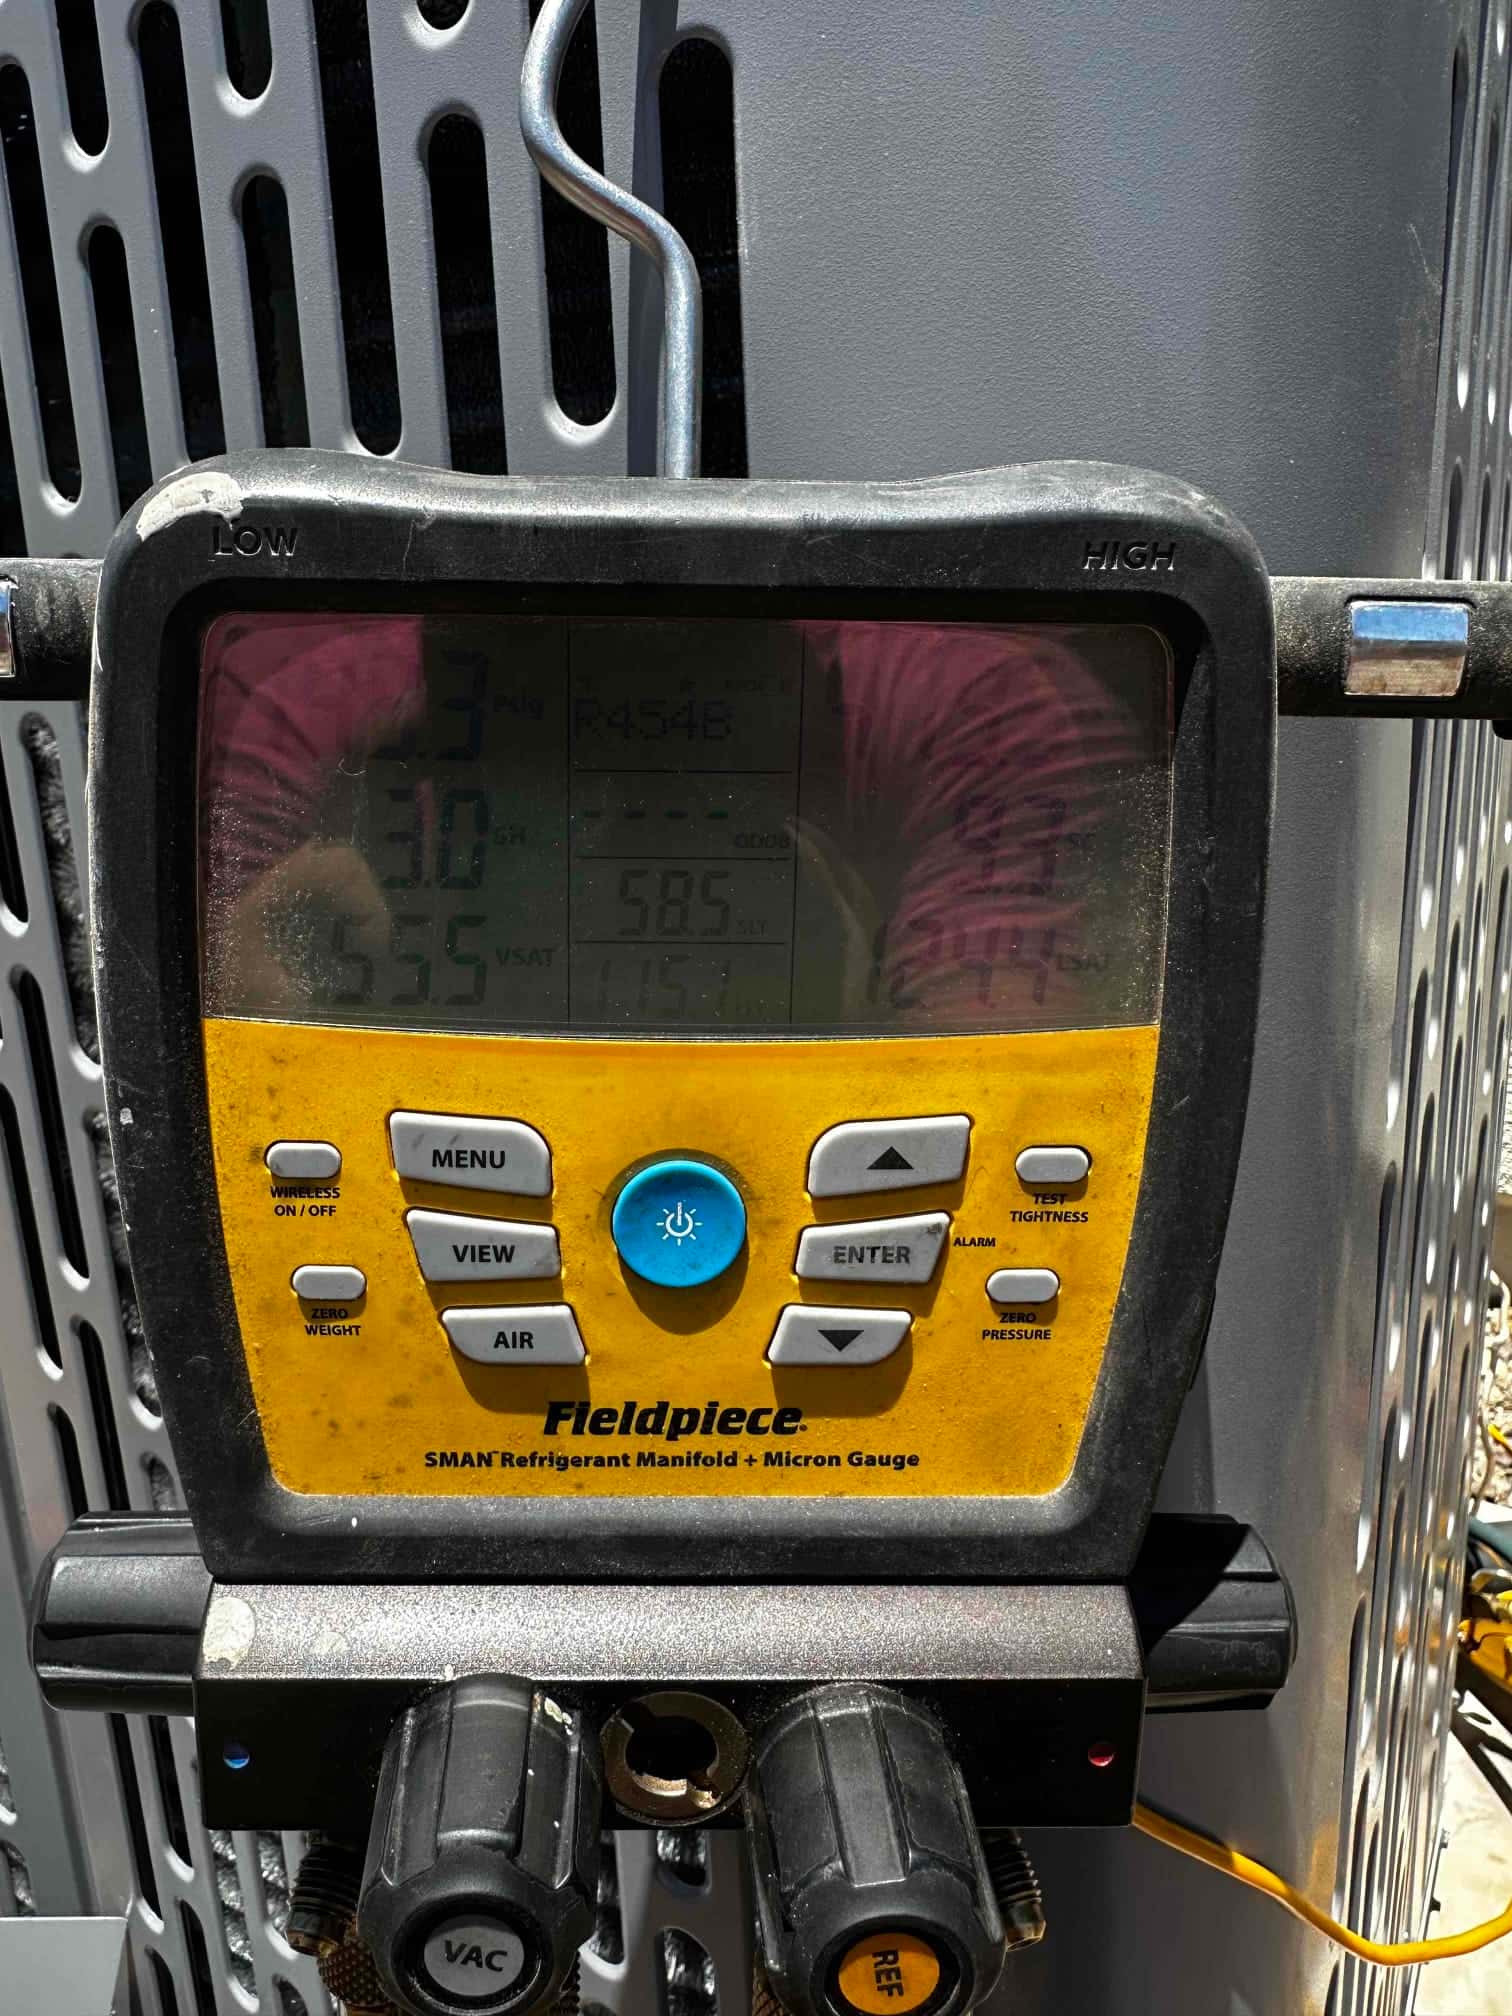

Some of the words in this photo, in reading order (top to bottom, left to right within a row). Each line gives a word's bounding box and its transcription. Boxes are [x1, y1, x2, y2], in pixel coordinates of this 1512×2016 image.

[211, 526, 298, 556] LOW
[1082, 541, 1177, 570] HIGH
[574, 697, 736, 741] R454B
[495, 945, 557, 968] VSAT
[432, 1149, 506, 1169] MENU
[270, 1186, 341, 1200] WIRELESS
[1032, 1193, 1069, 1205] TEST
[274, 1205, 297, 1217] ON
[308, 1205, 337, 1217] OFF
[1010, 1211, 1089, 1223] TIGHTNESS
[953, 1237, 996, 1247] ALARM
[452, 1245, 515, 1263] VIEW
[833, 1246, 911, 1264] ENTER
[311, 1308, 349, 1320] ZERO
[999, 1312, 1037, 1324] ZERO
[305, 1324, 362, 1336] WEIGHT
[981, 1329, 1051, 1340] PRESSURE
[493, 1331, 535, 1349] AIR
[501, 1451, 632, 1472] Refrigerant
[636, 1451, 738, 1468] Manifold
[763, 1450, 842, 1468] Micron
[847, 1451, 920, 1471] Gauge
[443, 1939, 508, 1973] VAC
[871, 1949, 904, 1998] REF
